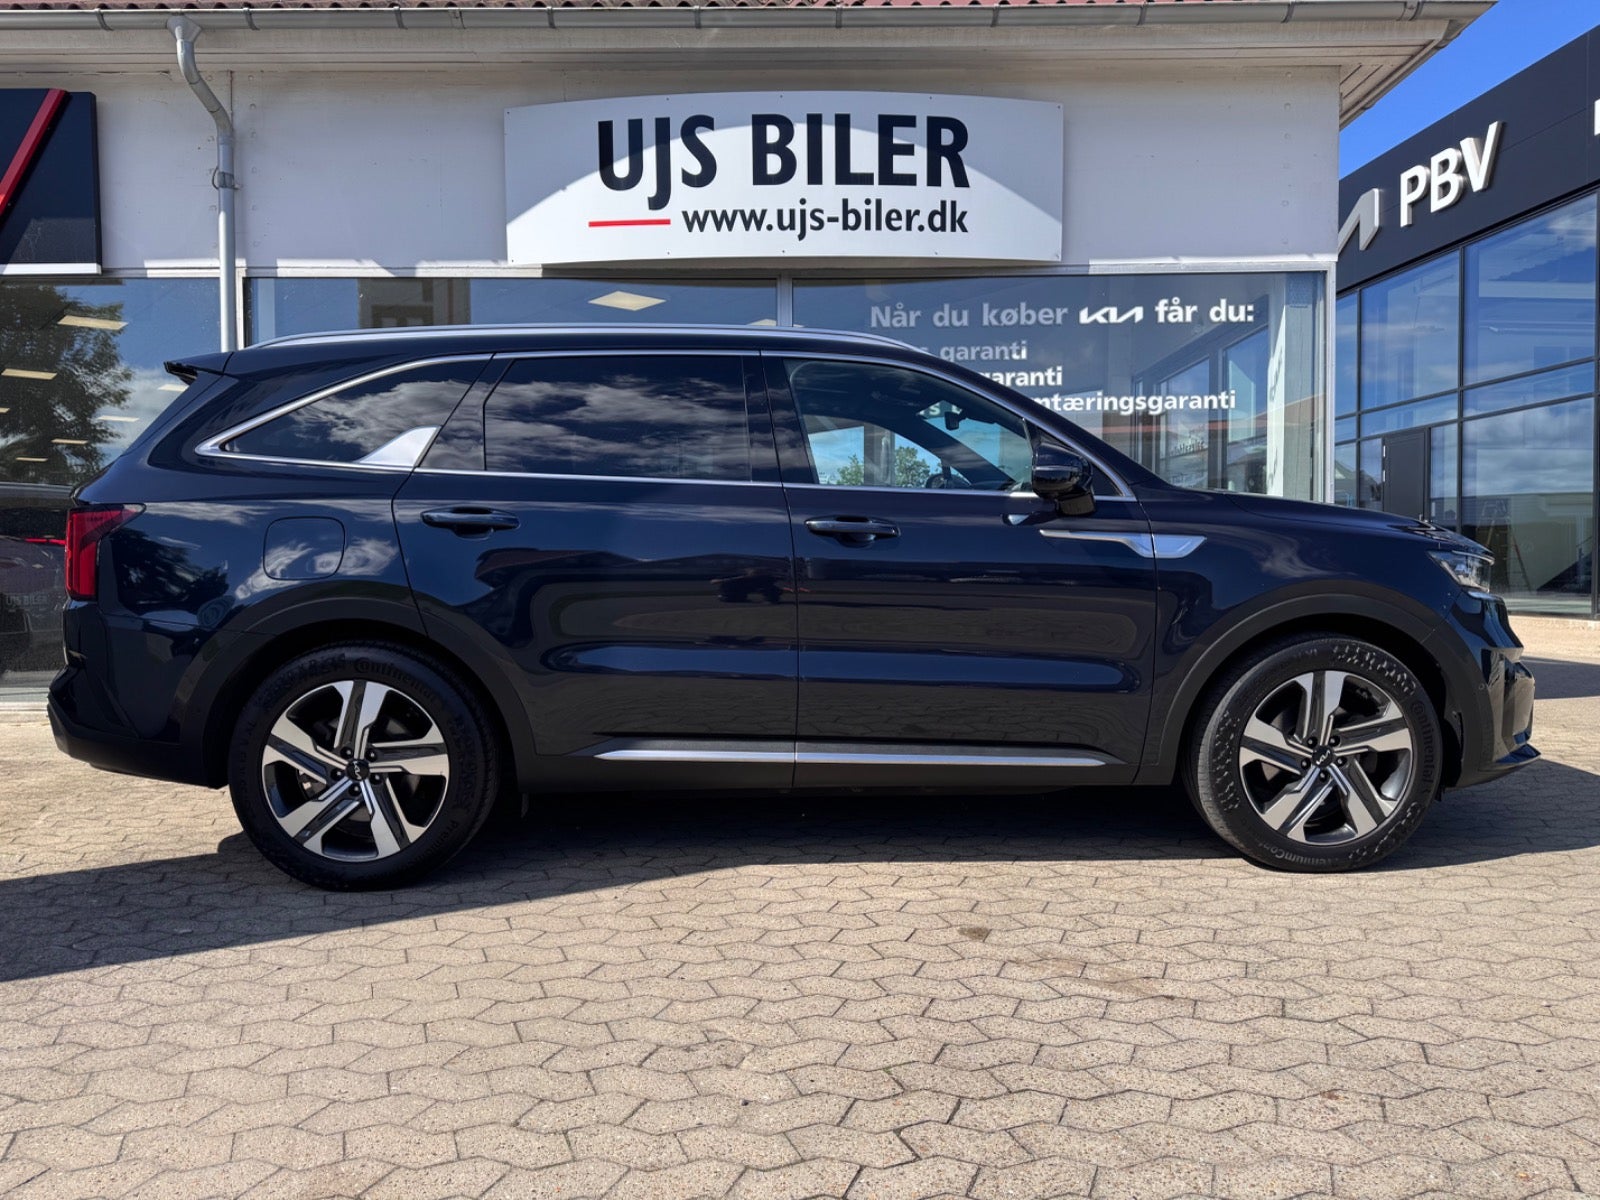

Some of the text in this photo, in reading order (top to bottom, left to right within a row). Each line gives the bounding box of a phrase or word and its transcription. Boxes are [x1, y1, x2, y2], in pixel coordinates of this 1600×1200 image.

[598, 113, 970, 210] UJS BILER
[1400, 121, 1502, 228] PBV
[681, 198, 968, 241] www.ujs-biler.dk
[870, 297, 1254, 328] Når du køber KIA får du:
